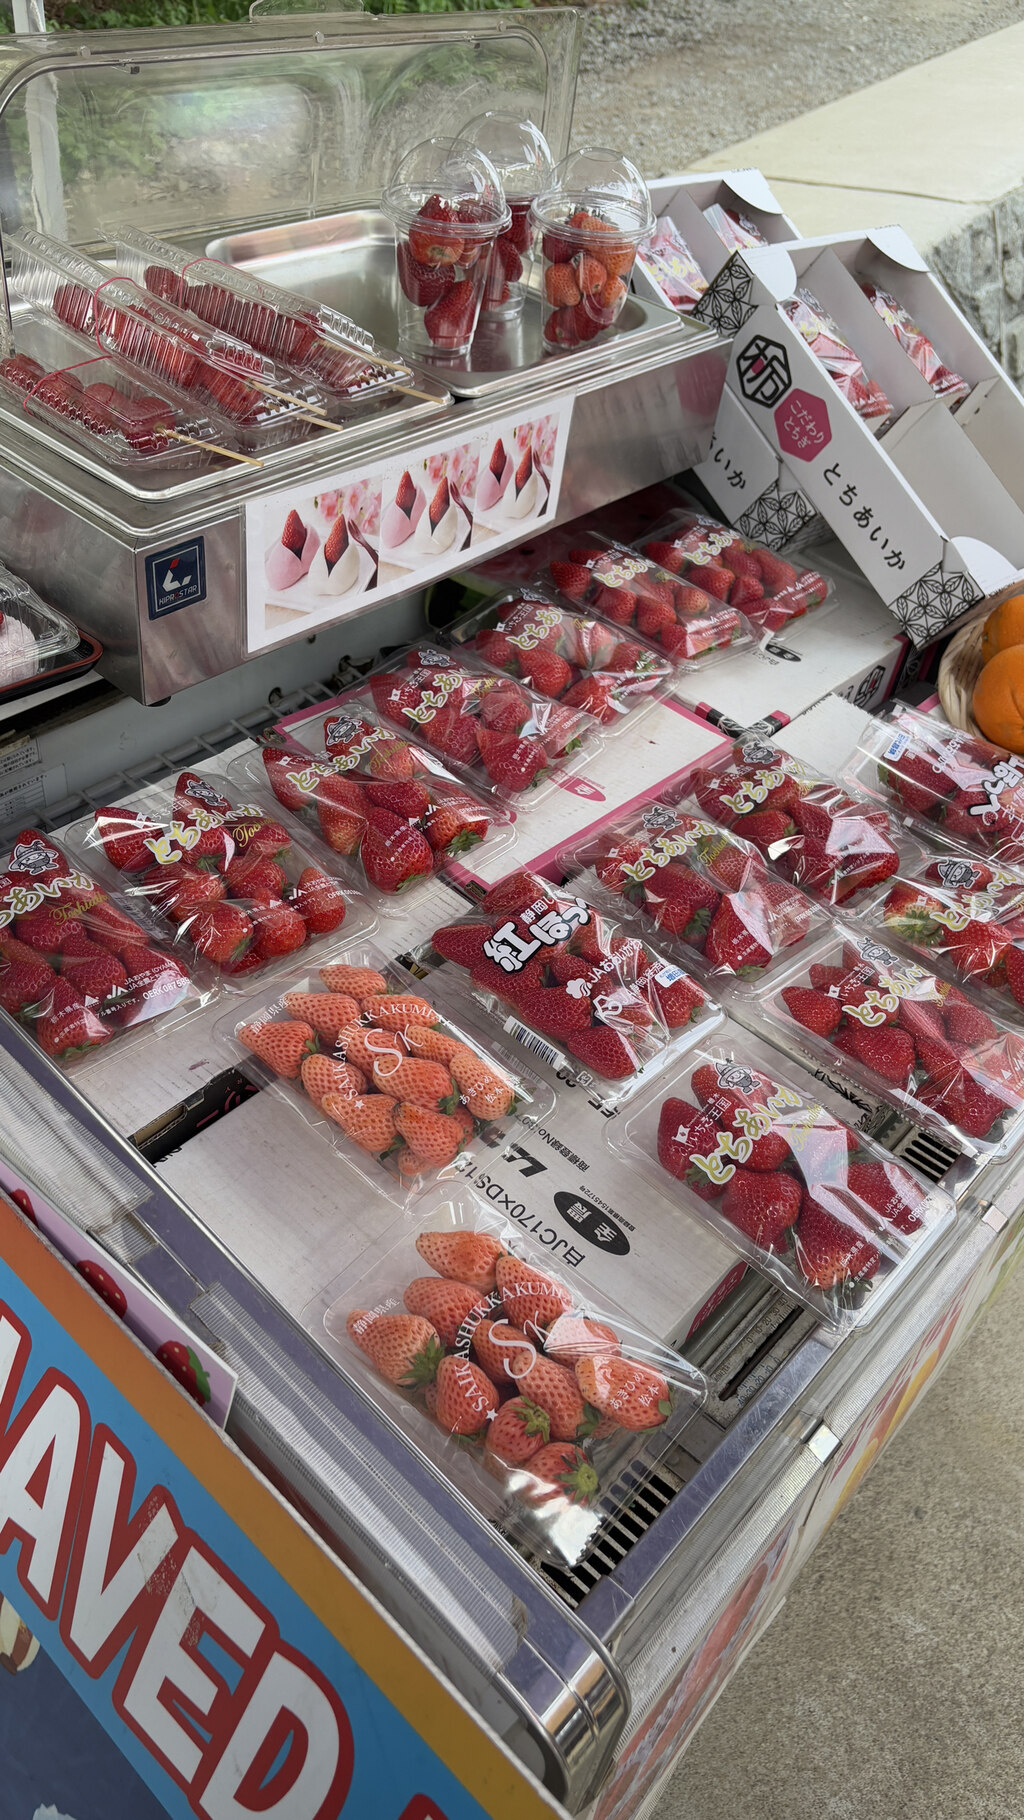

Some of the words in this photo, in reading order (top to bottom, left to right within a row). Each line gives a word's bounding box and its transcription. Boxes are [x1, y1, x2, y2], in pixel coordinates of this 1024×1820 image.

[783, 416, 812, 449] とちぎ
[790, 400, 824, 443] こだわり
[823, 462, 905, 570] とちあいか
[158, 584, 198, 606] HIPROSTAR
[482, 897, 593, 974] 紅ほっ
[251, 996, 292, 1035] 静岡県産
[485, 1085, 505, 1105] 松本
[688, 1083, 804, 1185] とちあいか
[566, 1201, 618, 1243] 全農
[352, 1296, 400, 1336] 静岡県産
[609, 1371, 645, 1411] あきひめ
[638, 1383, 660, 1408] 松本
